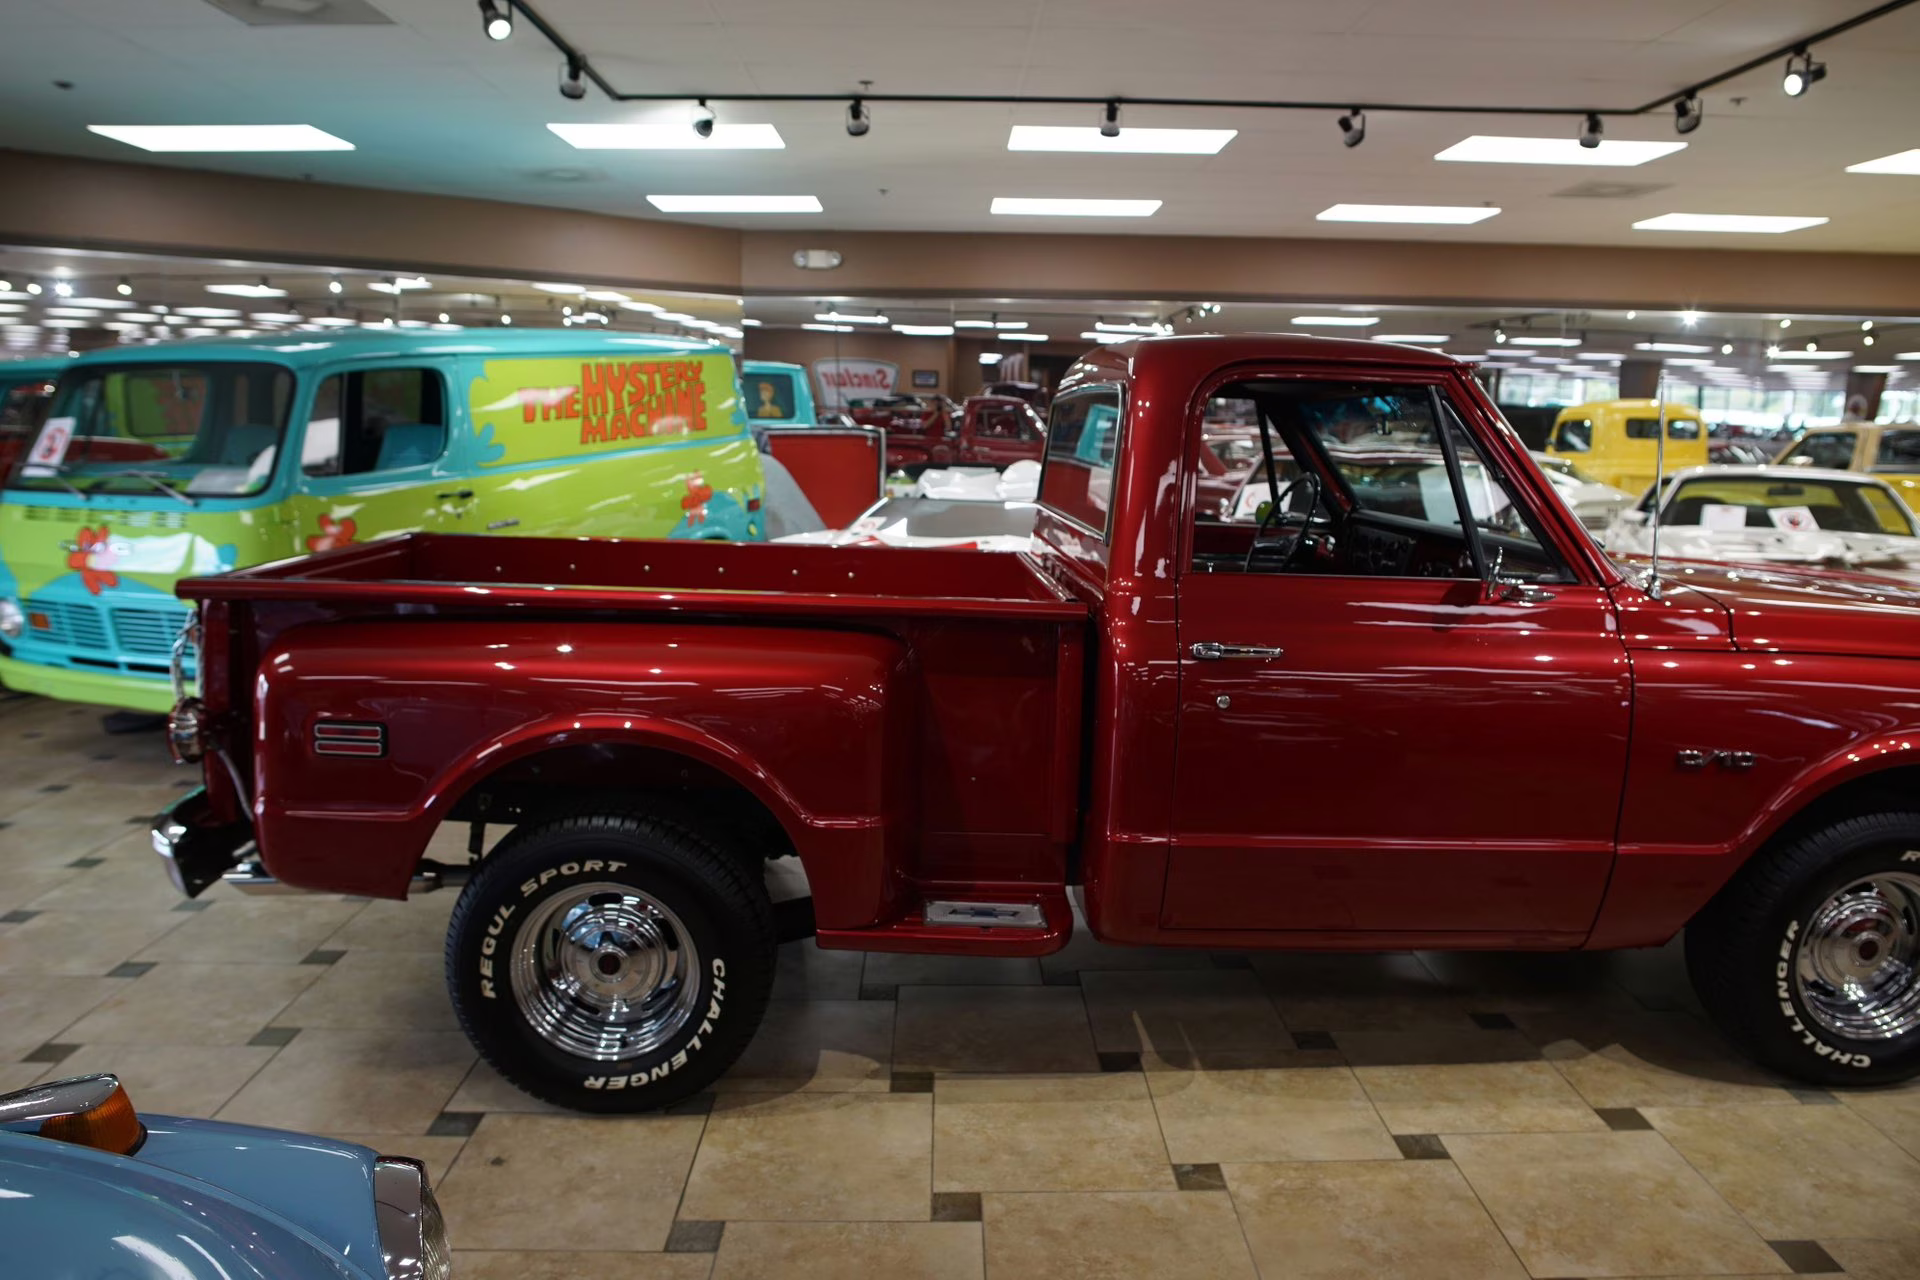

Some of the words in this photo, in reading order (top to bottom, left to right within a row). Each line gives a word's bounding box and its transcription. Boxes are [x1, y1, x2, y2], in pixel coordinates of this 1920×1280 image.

[518, 385, 580, 423] THE
[582, 360, 703, 417] MYSTERY
[580, 381, 707, 444] MACHINE
[479, 903, 516, 999] REGUL
[520, 859, 627, 898] SPORT
[1777, 919, 1872, 1068] CHALLENGER
[583, 957, 726, 1090] CHALLENGER
